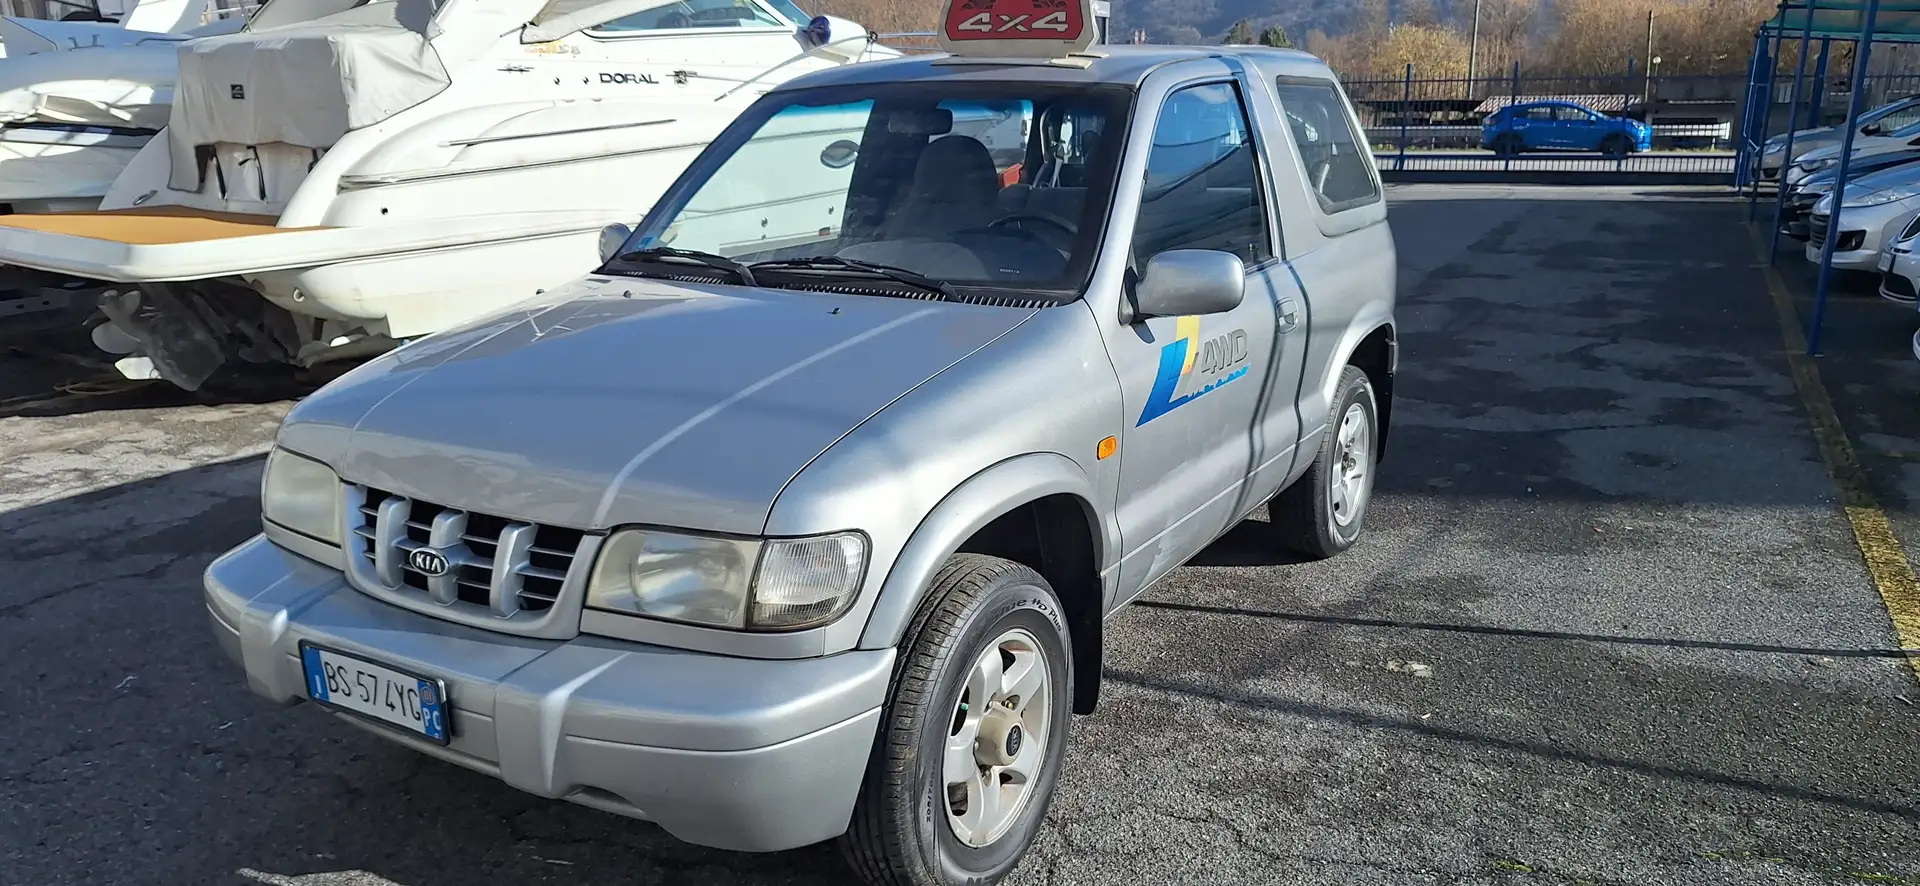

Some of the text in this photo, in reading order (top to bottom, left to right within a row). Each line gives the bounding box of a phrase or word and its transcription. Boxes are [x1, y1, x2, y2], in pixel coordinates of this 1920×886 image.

[599, 72, 660, 85] DORAL
[1200, 328, 1248, 375] 4WD
[415, 551, 442, 573] KIA
[422, 707, 443, 731] PC
